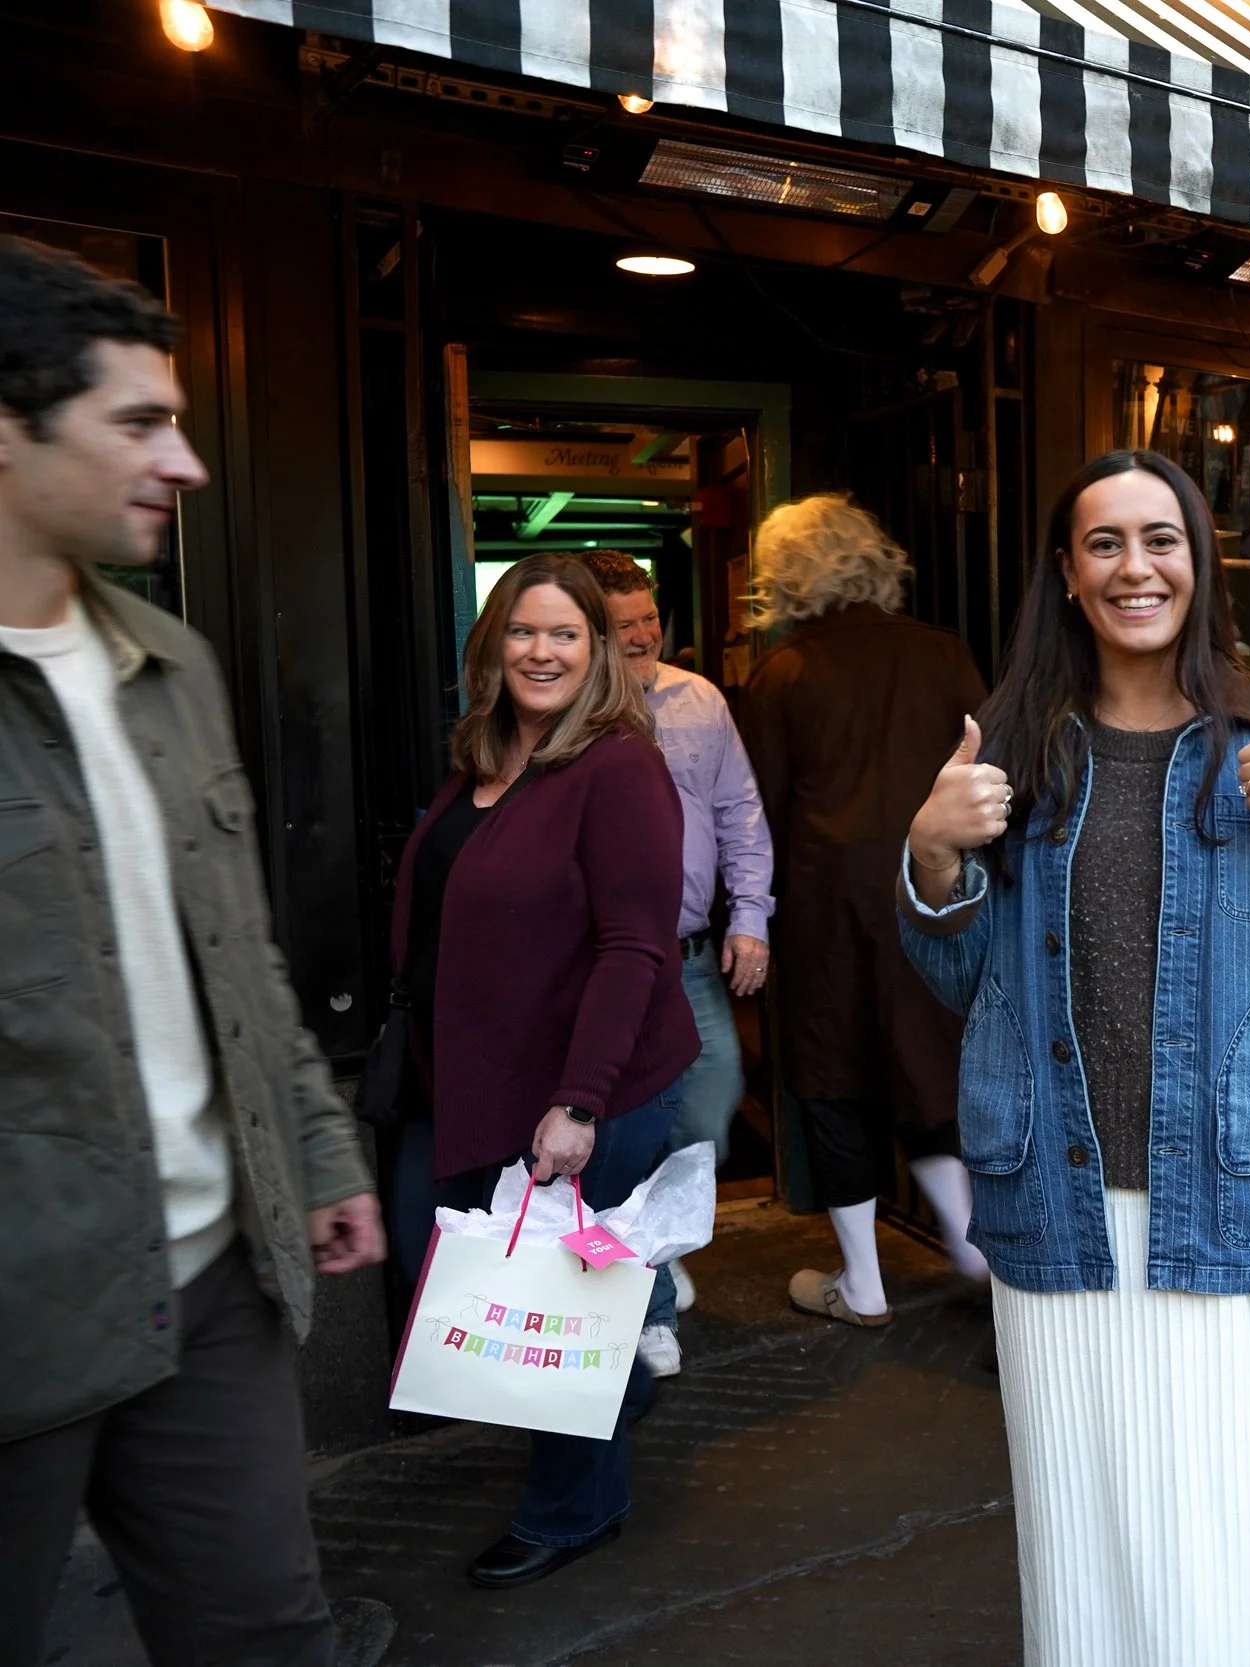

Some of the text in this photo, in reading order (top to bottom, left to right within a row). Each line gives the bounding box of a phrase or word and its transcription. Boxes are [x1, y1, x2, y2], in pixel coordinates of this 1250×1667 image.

[544, 447, 621, 476] Meeting
[586, 1240, 603, 1248] TO
[588, 1243, 615, 1255] YOU!
[490, 1308, 578, 1330] HAPPY
[450, 1332, 599, 1364] BIRTHDAY
